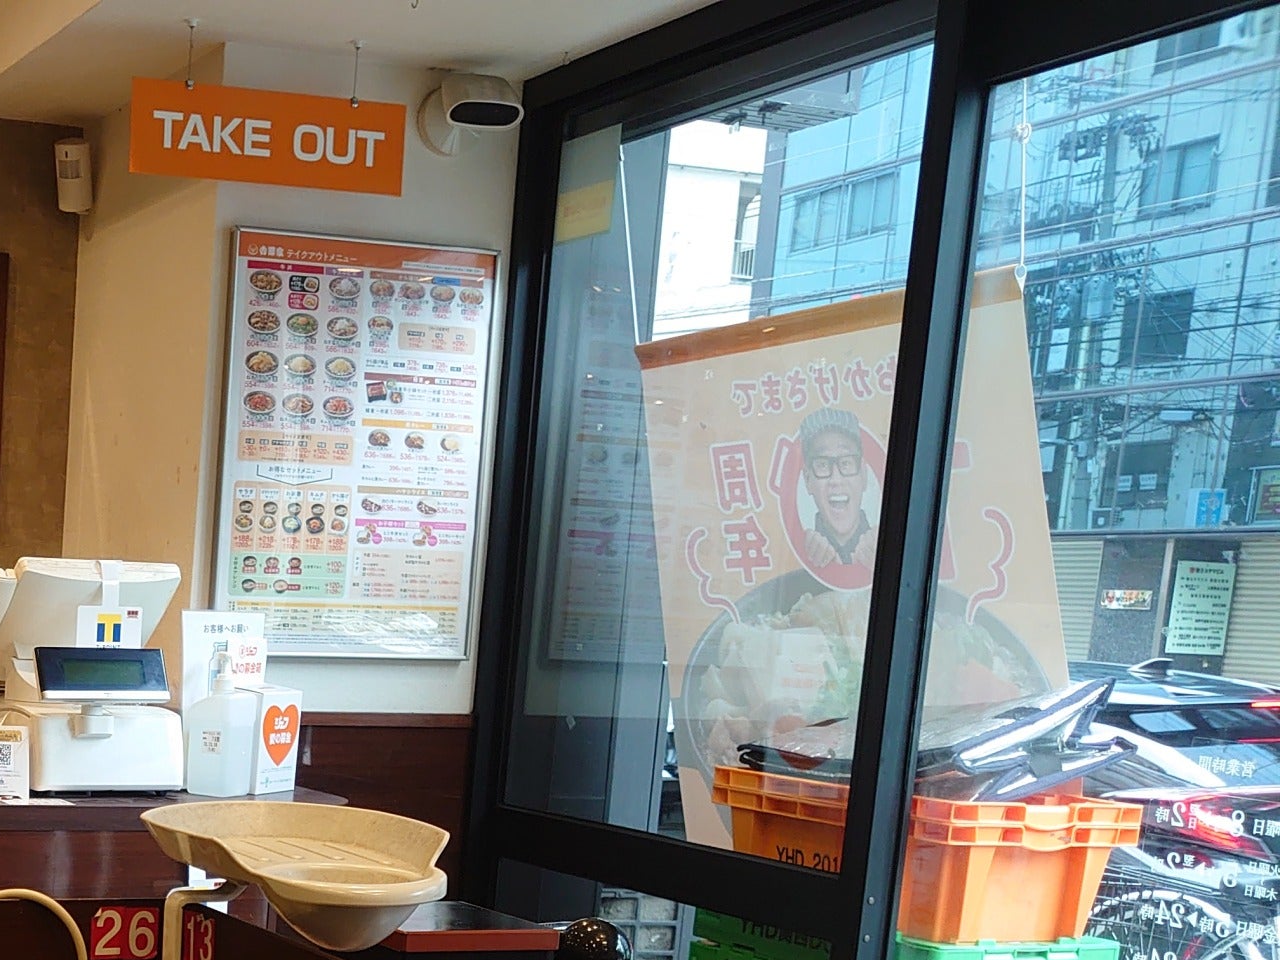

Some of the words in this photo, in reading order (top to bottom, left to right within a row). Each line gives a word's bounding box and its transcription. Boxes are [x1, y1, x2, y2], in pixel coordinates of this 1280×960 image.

[153, 109, 272, 157] TAKE
[293, 124, 385, 168] OUT
[287, 250, 358, 264] テイクアウトメニュー
[203, 623, 250, 635] お客様へお願い
[776, 844, 804, 867] YHD
[94, 909, 156, 957] 26
